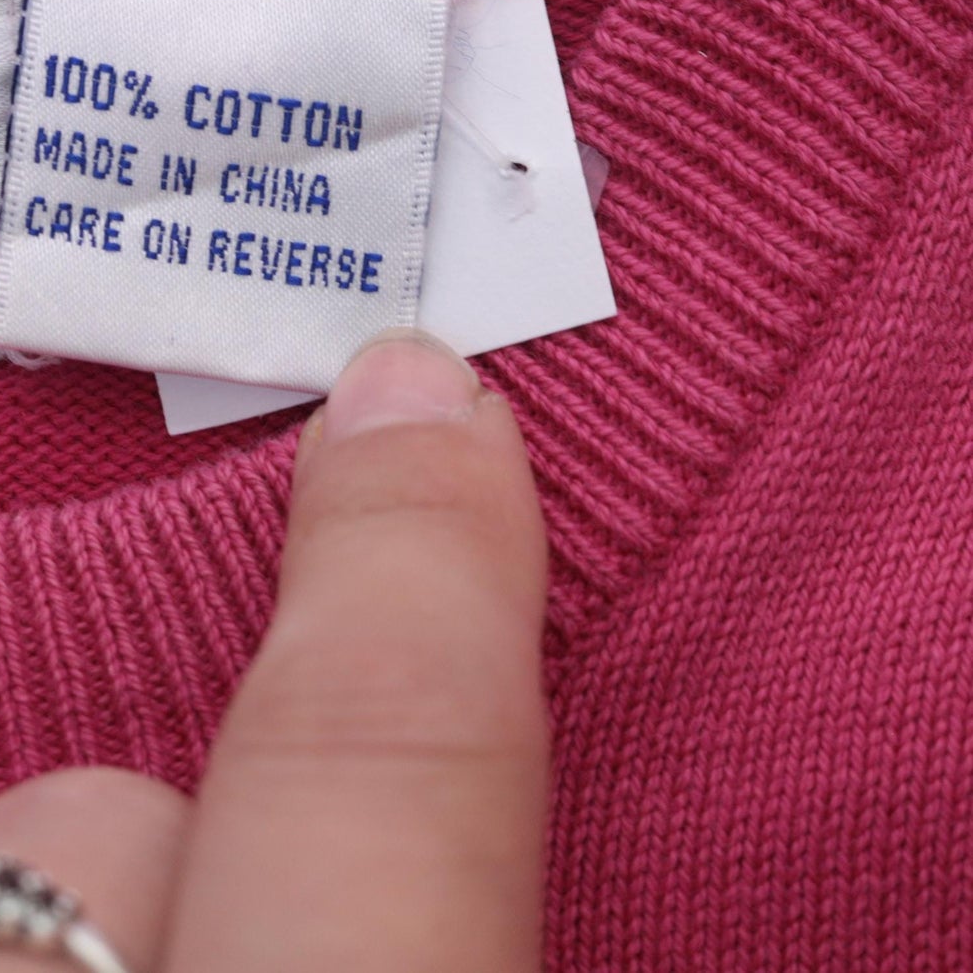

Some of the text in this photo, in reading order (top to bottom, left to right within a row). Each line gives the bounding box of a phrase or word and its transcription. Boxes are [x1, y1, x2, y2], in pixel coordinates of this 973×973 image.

[43, 53, 363, 151] 100% COTTON
[34, 127, 331, 215] MADE IN CHINA
[25, 195, 384, 293] CARE ON REVERSE
